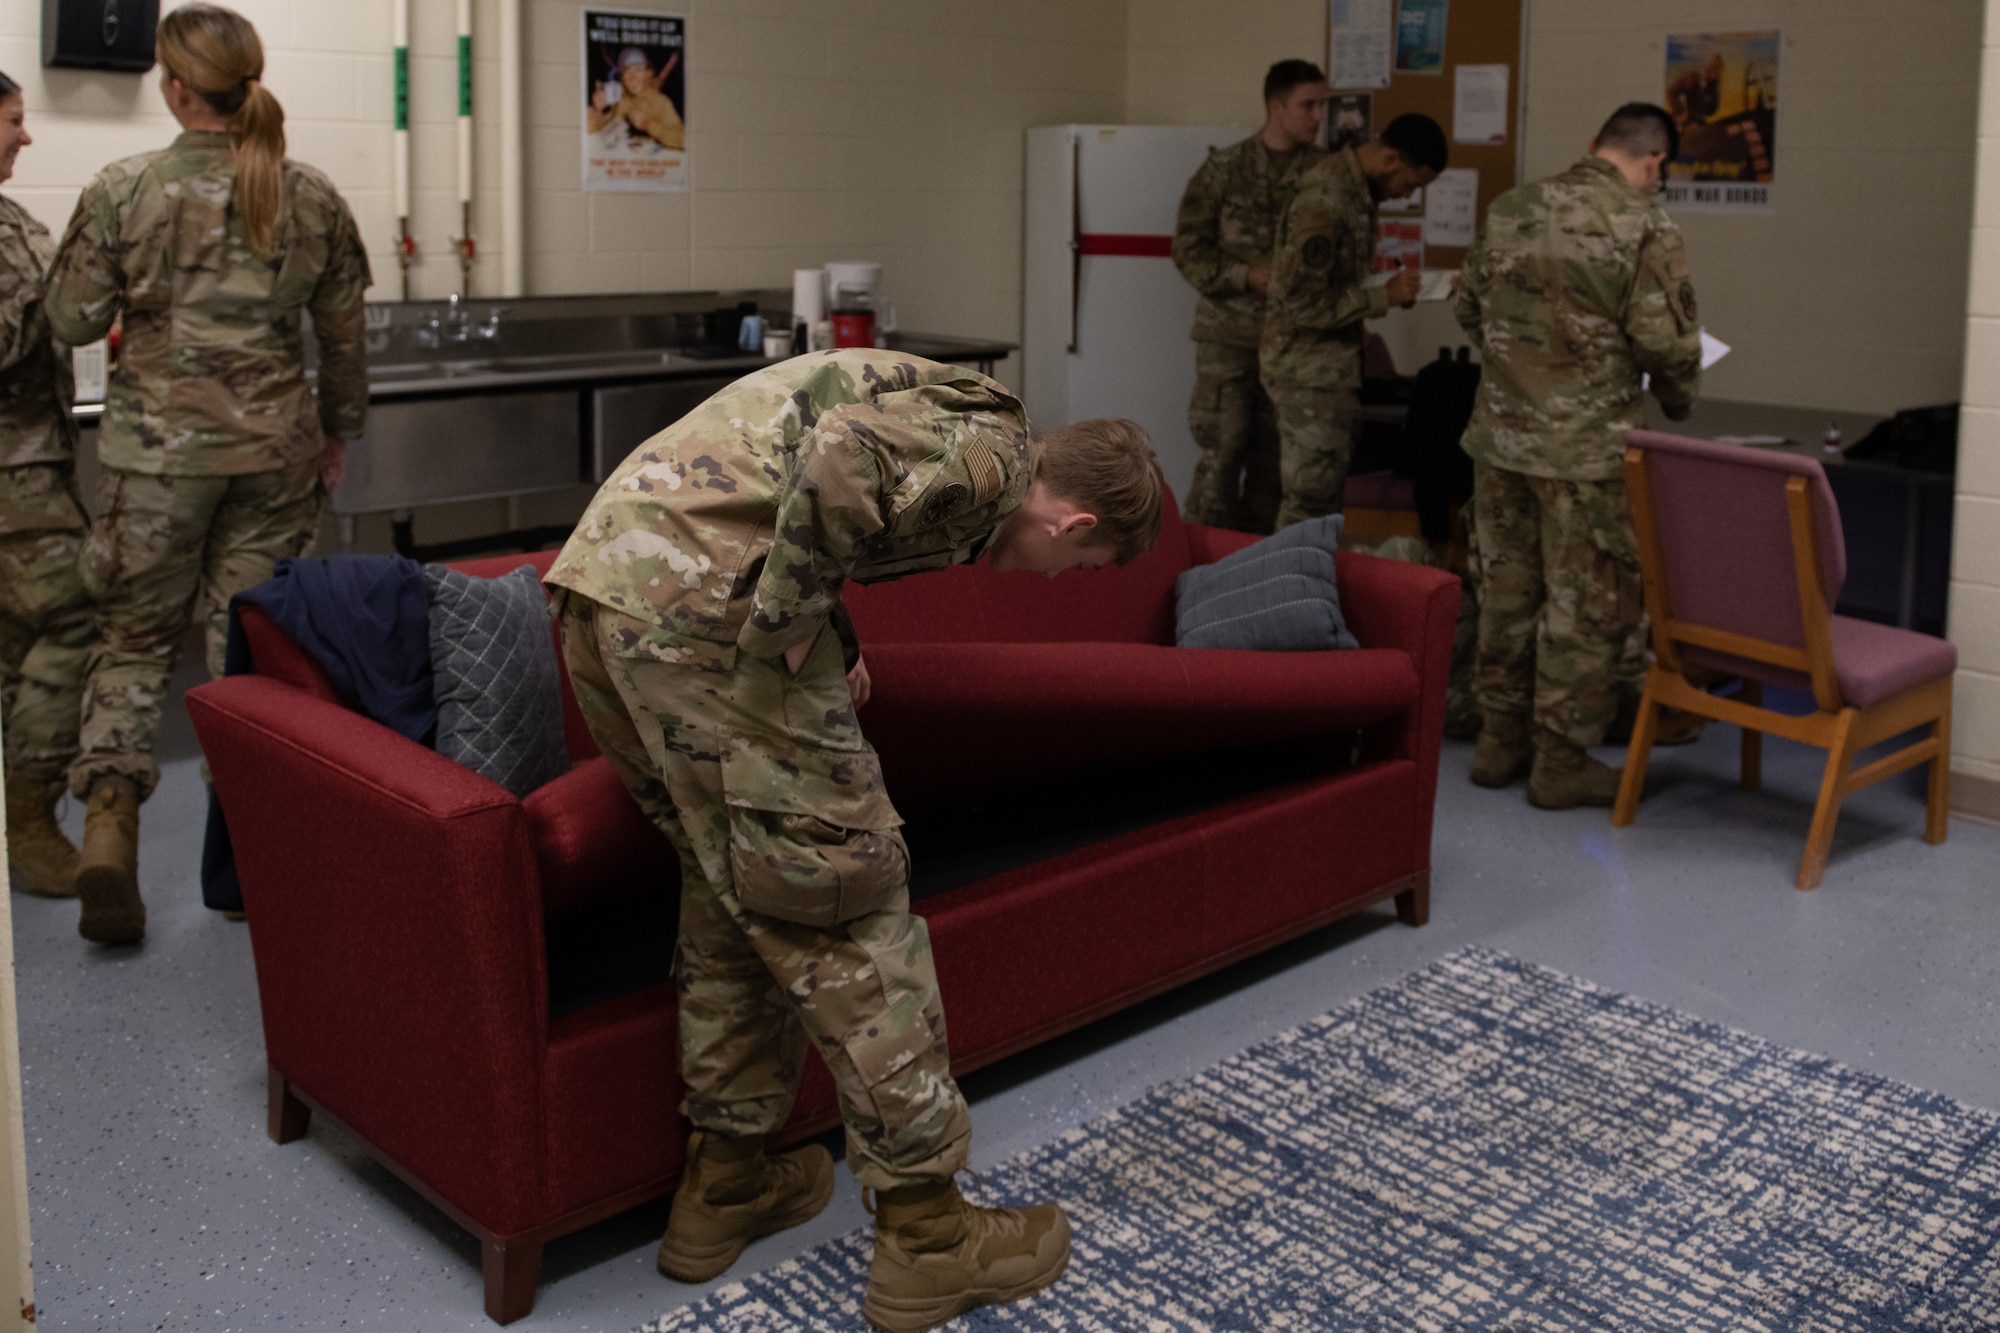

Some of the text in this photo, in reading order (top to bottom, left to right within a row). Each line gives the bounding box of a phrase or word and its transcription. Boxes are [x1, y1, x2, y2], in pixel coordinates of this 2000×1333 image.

[595, 16, 619, 29] YOU
[660, 20, 677, 33] UP
[1666, 186, 1767, 203] BUY WAR BONDS
